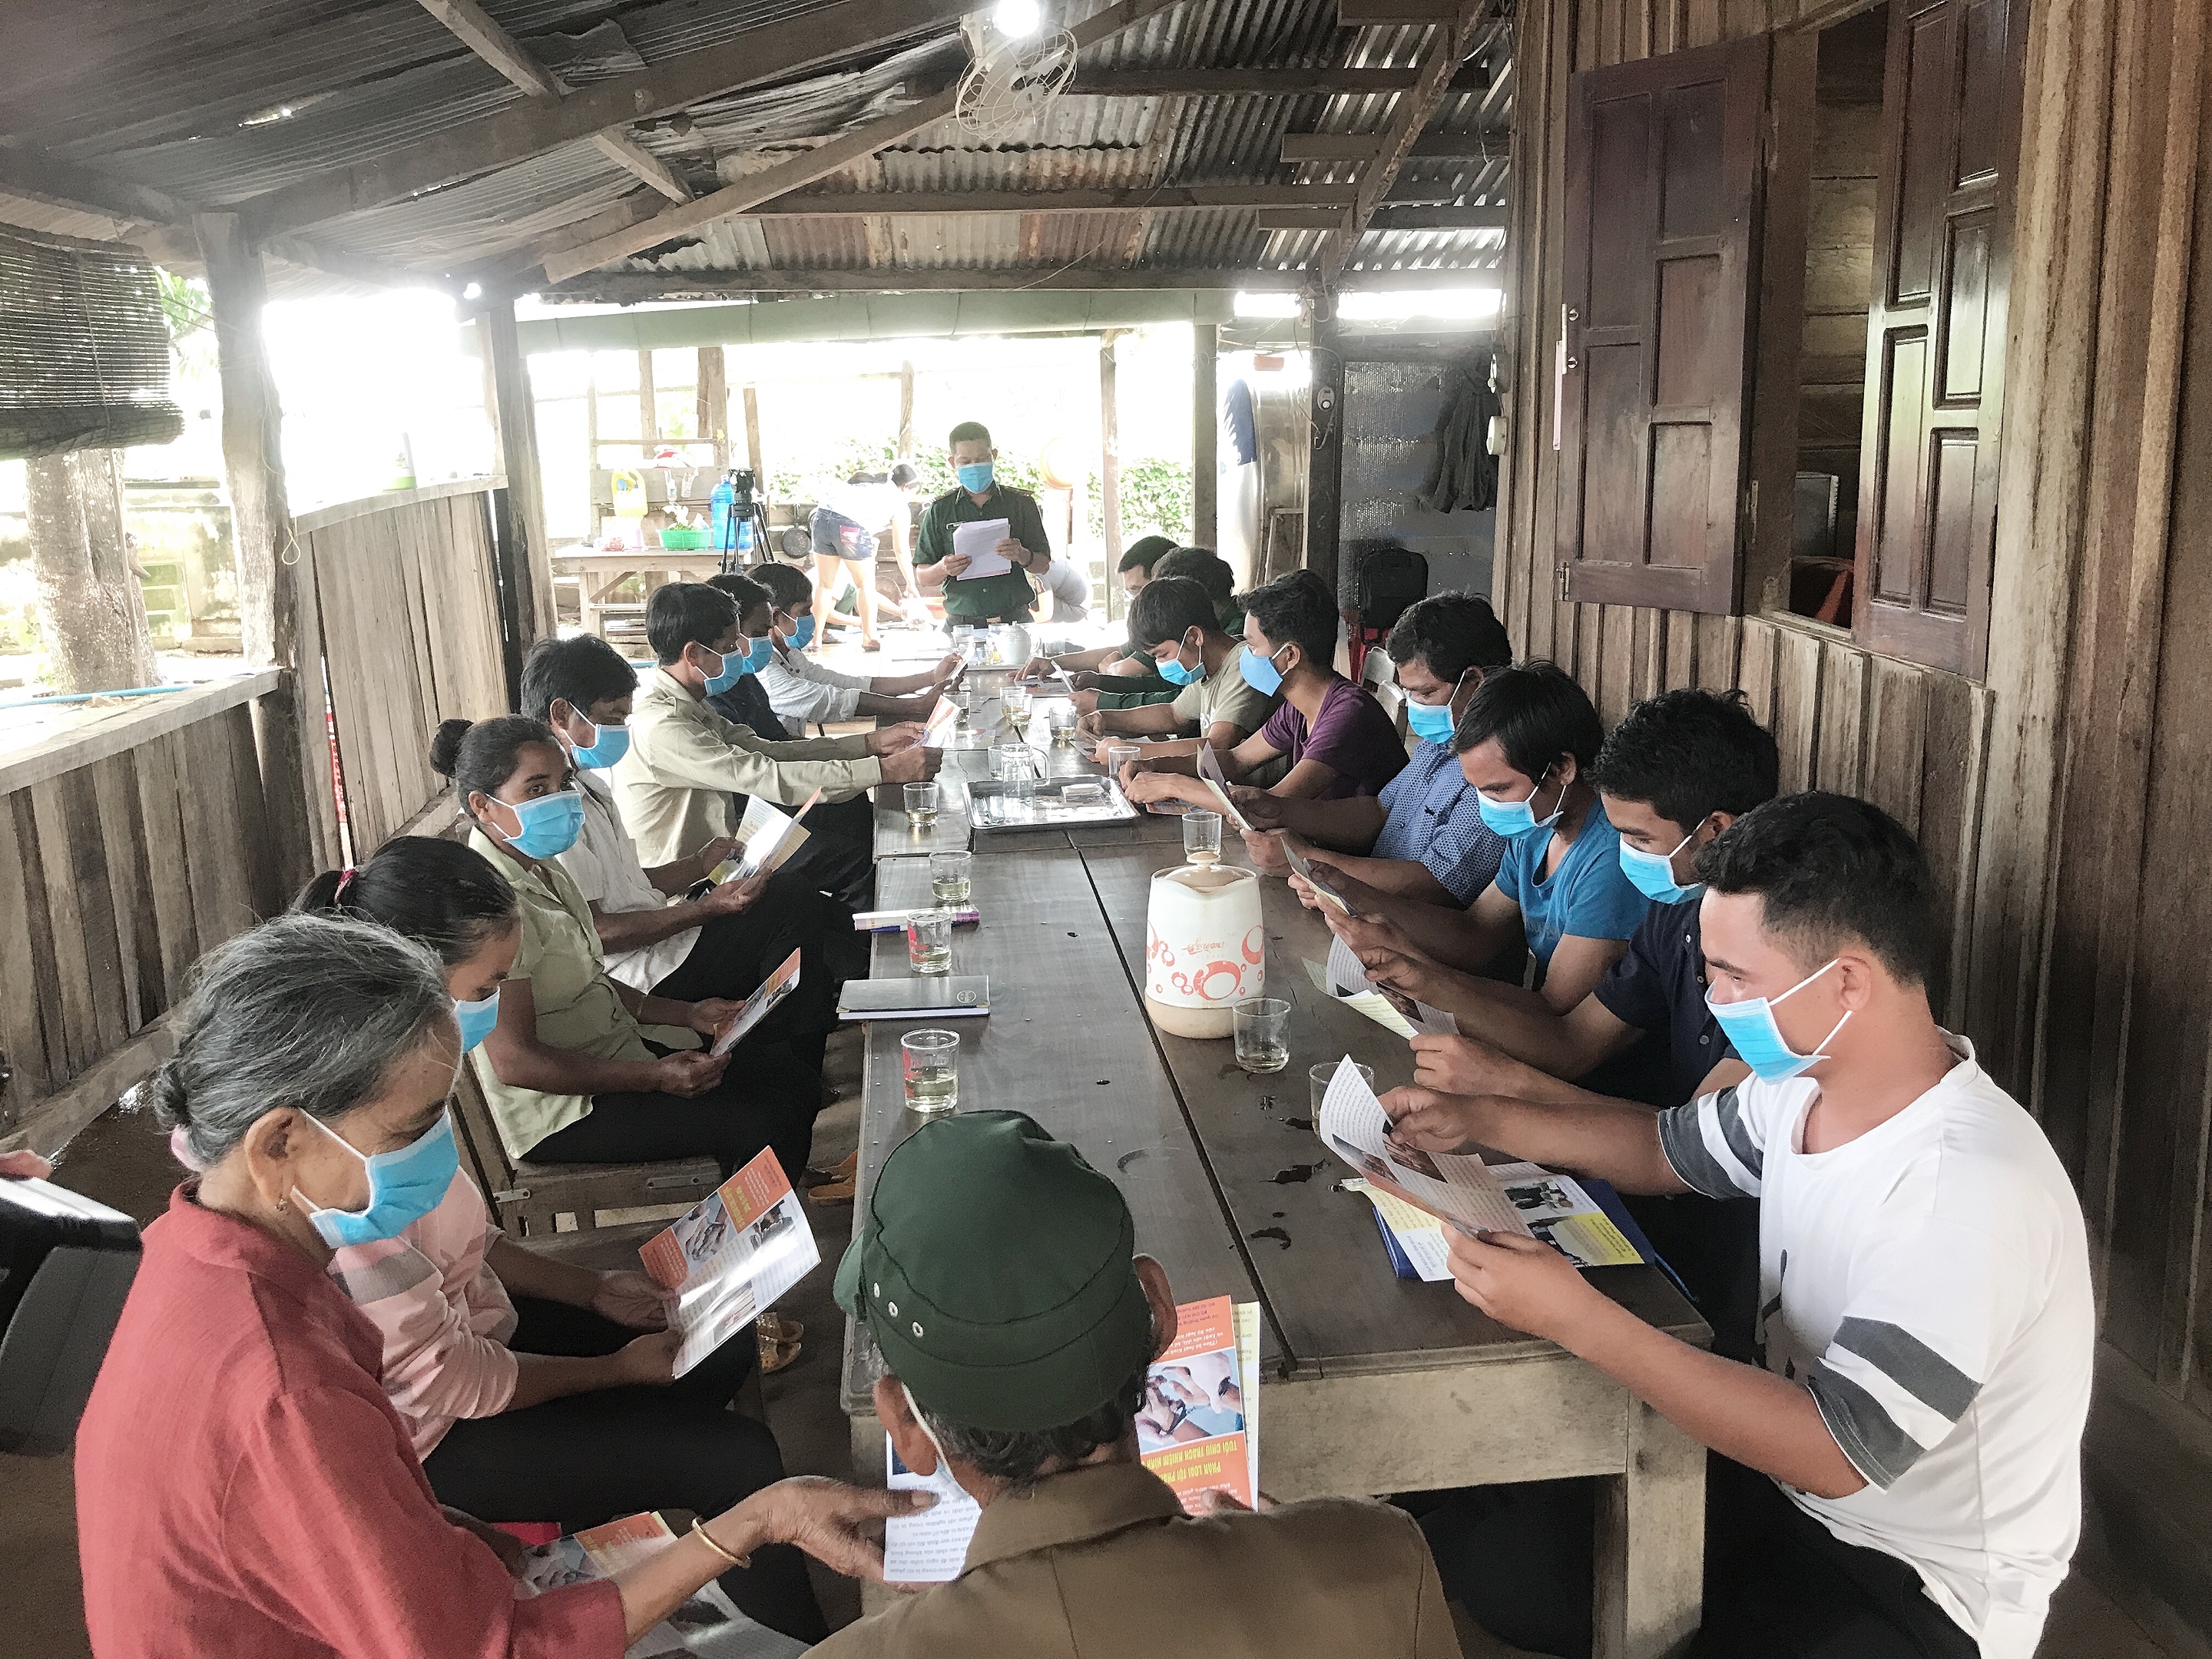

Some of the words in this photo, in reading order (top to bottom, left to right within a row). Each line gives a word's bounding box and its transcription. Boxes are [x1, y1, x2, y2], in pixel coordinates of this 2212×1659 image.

[1221, 1439, 1238, 1456] TUỔI
[1175, 1468, 1187, 1480] TỘI
[1186, 1462, 1202, 1477] LOẠI
